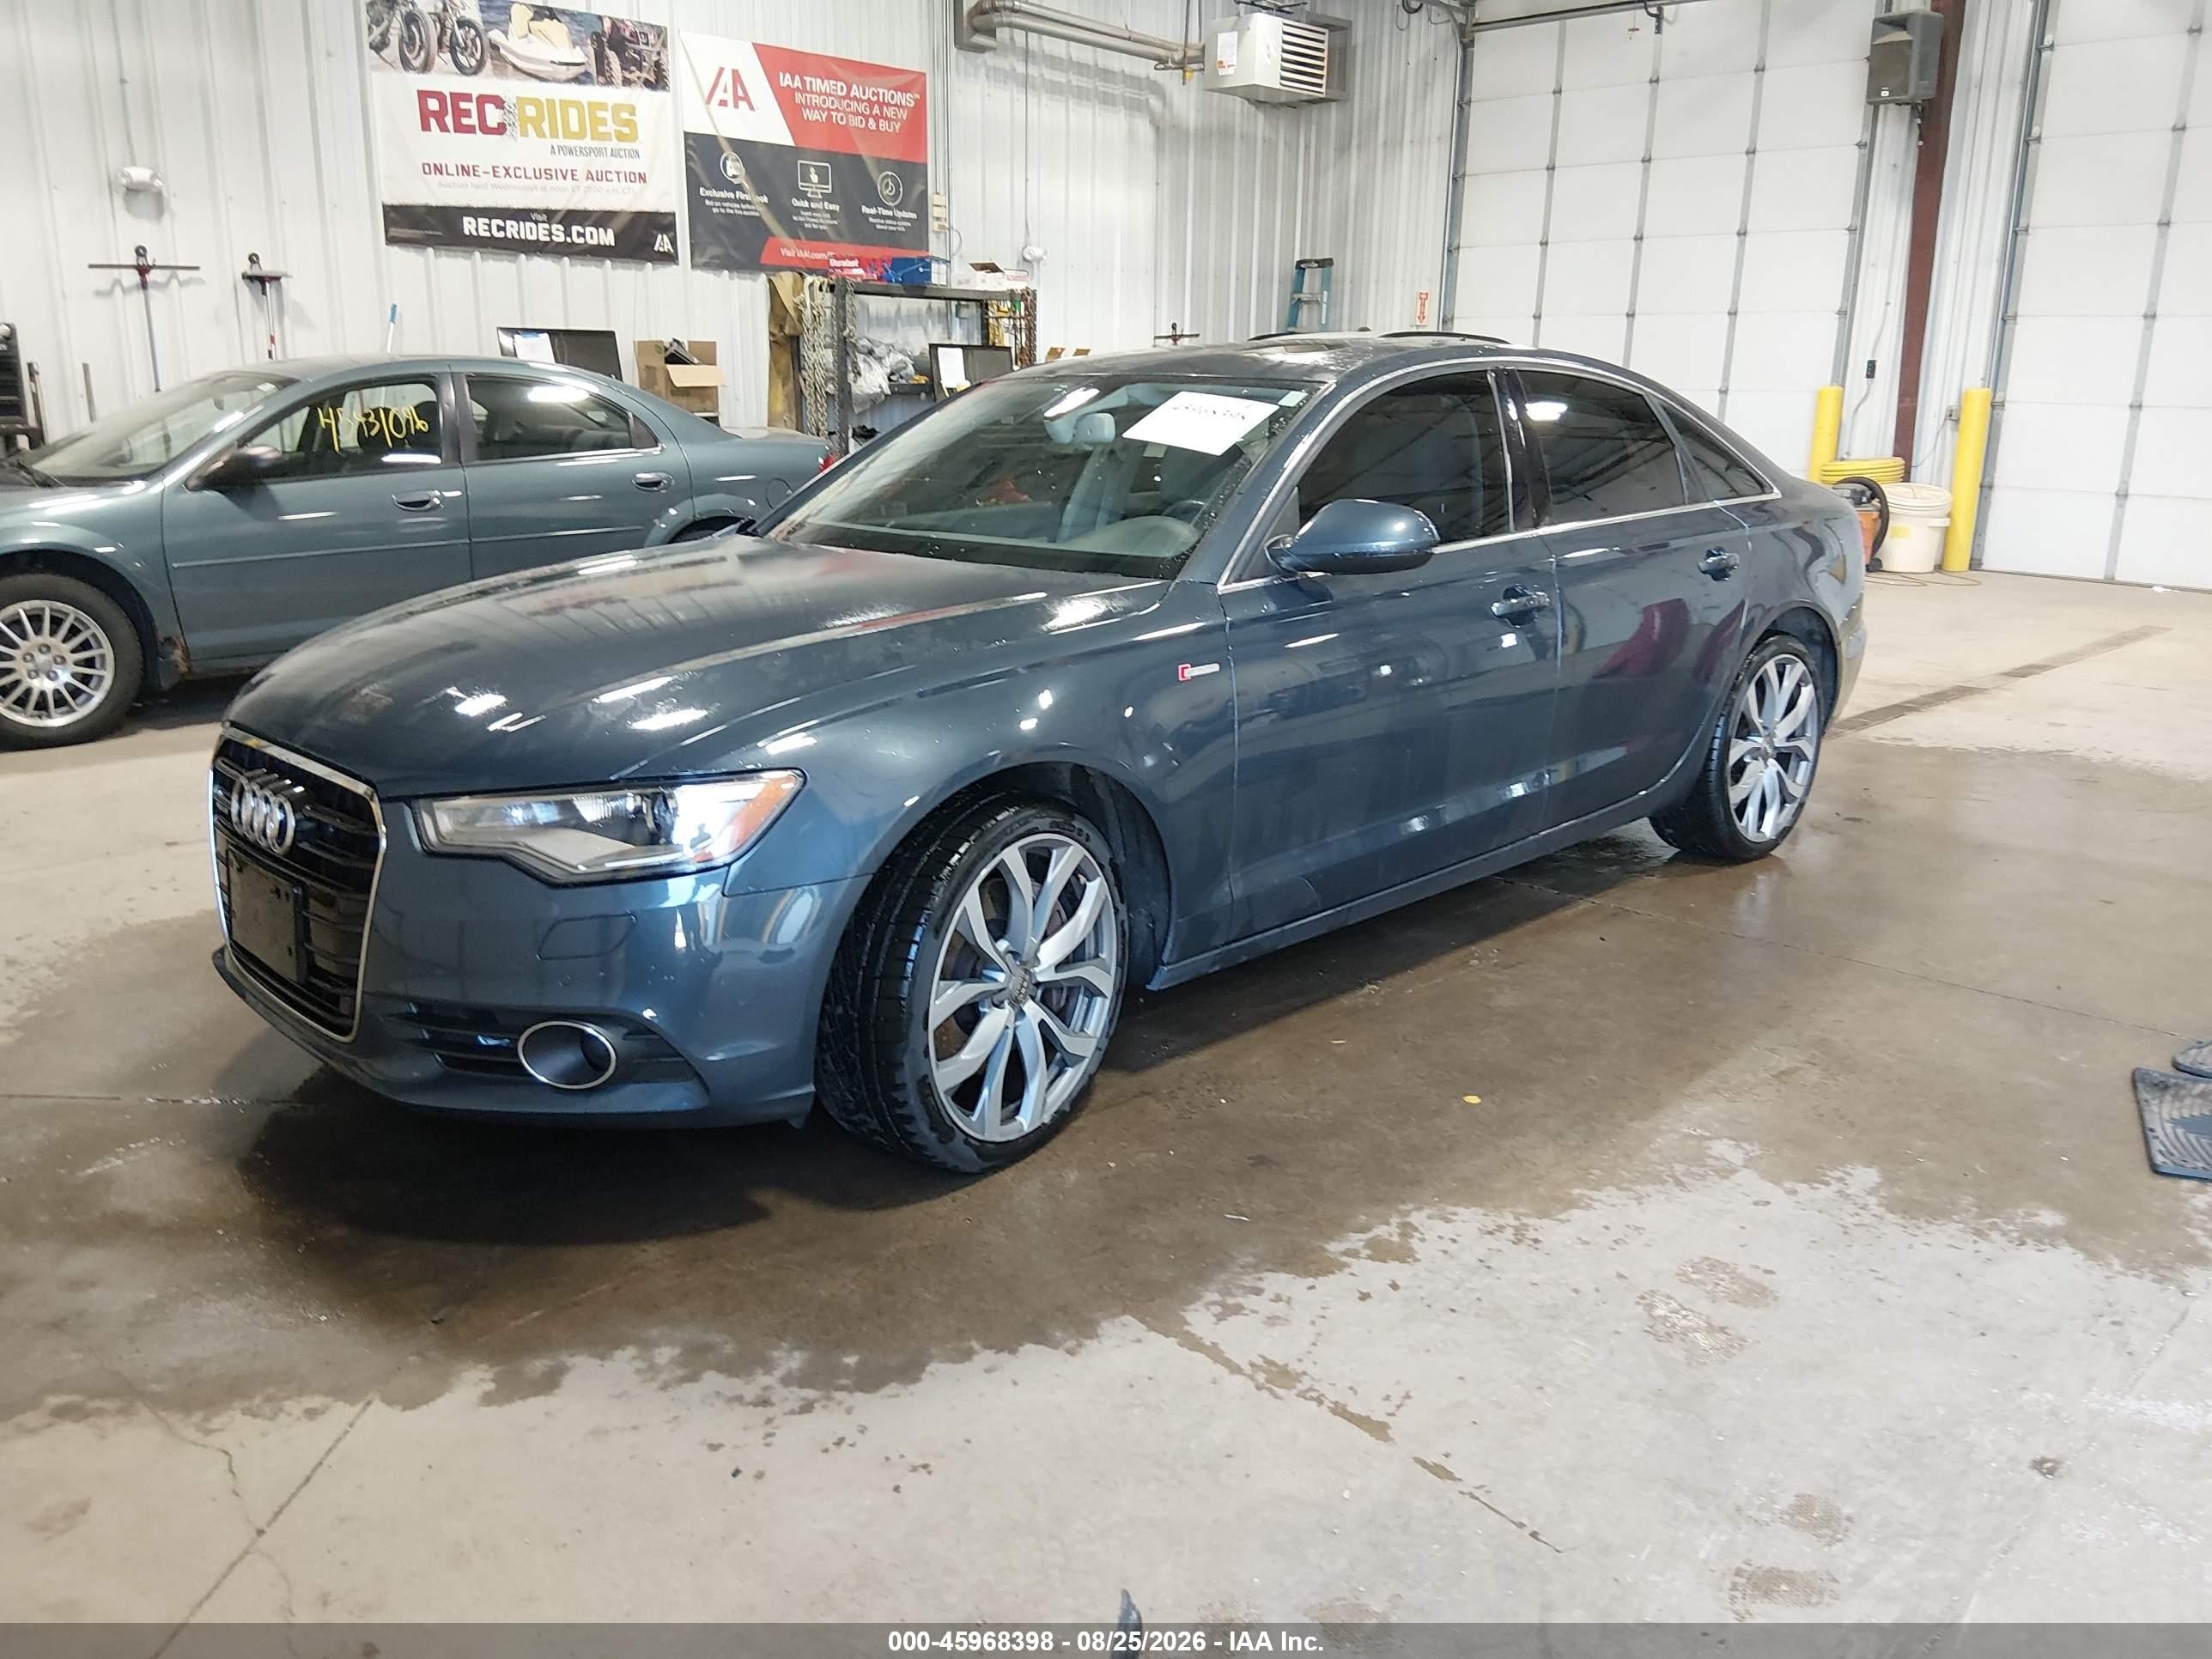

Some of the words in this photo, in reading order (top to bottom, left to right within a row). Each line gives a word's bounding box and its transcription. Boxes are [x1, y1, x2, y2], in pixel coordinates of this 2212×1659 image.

[779, 71, 803, 90] IAA
[803, 76, 847, 96] TIMED
[416, 89, 507, 136] REC
[516, 96, 639, 143] RIDES
[795, 91, 870, 115] INTRODUCING
[872, 104, 881, 116] A
[883, 107, 908, 121] NEW
[802, 108, 828, 124] WAY
[830, 111, 847, 125] TO
[848, 114, 866, 128] BID
[867, 118, 877, 131] &
[878, 120, 901, 133] BUY
[550, 144, 556, 156] A
[557, 144, 608, 158] POWERSPORT
[610, 147, 641, 160] AUCTION
[422, 161, 580, 182] ONLINE-EXCLUSIVE
[586, 168, 647, 185] AUCTION
[791, 197, 810, 209] Quick
[810, 200, 823, 210] and
[823, 200, 841, 214] Easy
[861, 204, 894, 216] Real-Time
[463, 216, 616, 246] RECRIDES.COM
